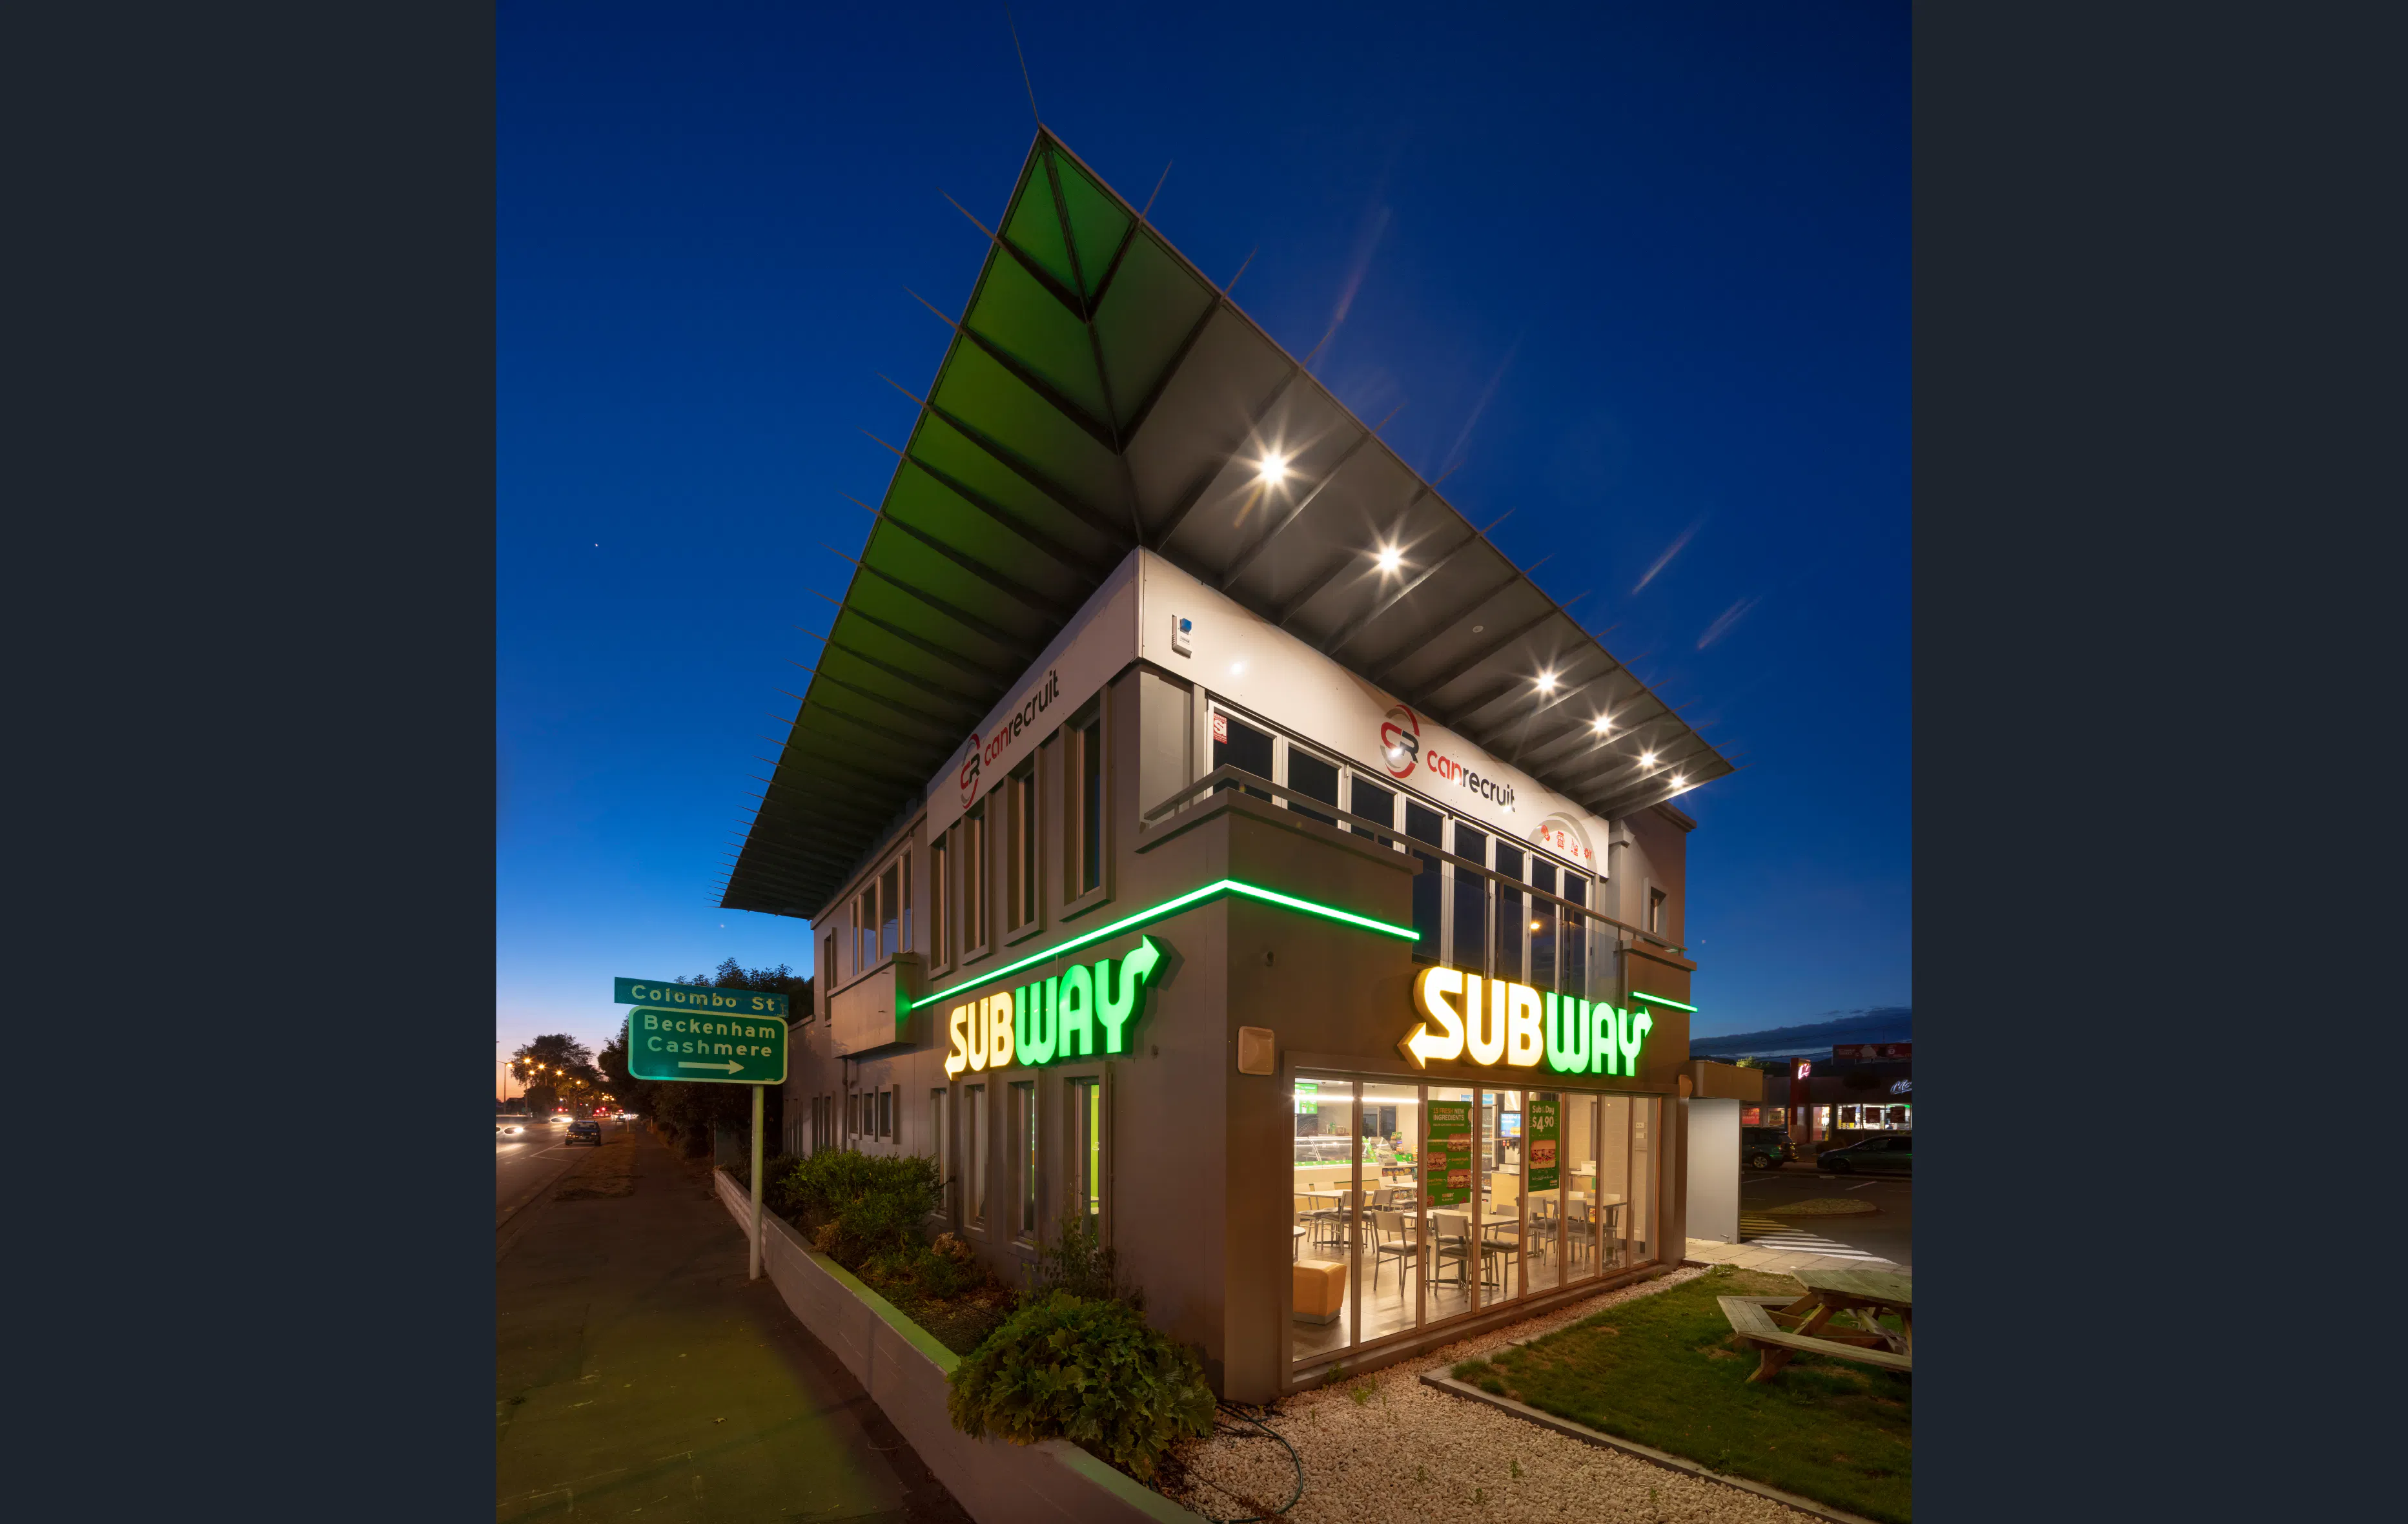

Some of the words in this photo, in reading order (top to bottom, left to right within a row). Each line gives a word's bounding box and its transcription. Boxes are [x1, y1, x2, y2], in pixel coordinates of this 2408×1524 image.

[985, 668, 1059, 767] canrecruit
[1427, 750, 1516, 813] canrecruit
[631, 985, 737, 1008] Colombo
[751, 996, 775, 1011] St
[944, 934, 1162, 1081] SUBWAY
[644, 1014, 775, 1039] Beckenham
[1401, 966, 1653, 1076] SUBWAY
[648, 1036, 771, 1057] Cashmere
[1532, 1105, 1542, 1113] Sub
[1545, 1105, 1555, 1115] Day
[1532, 1115, 1554, 1133] $4.90
